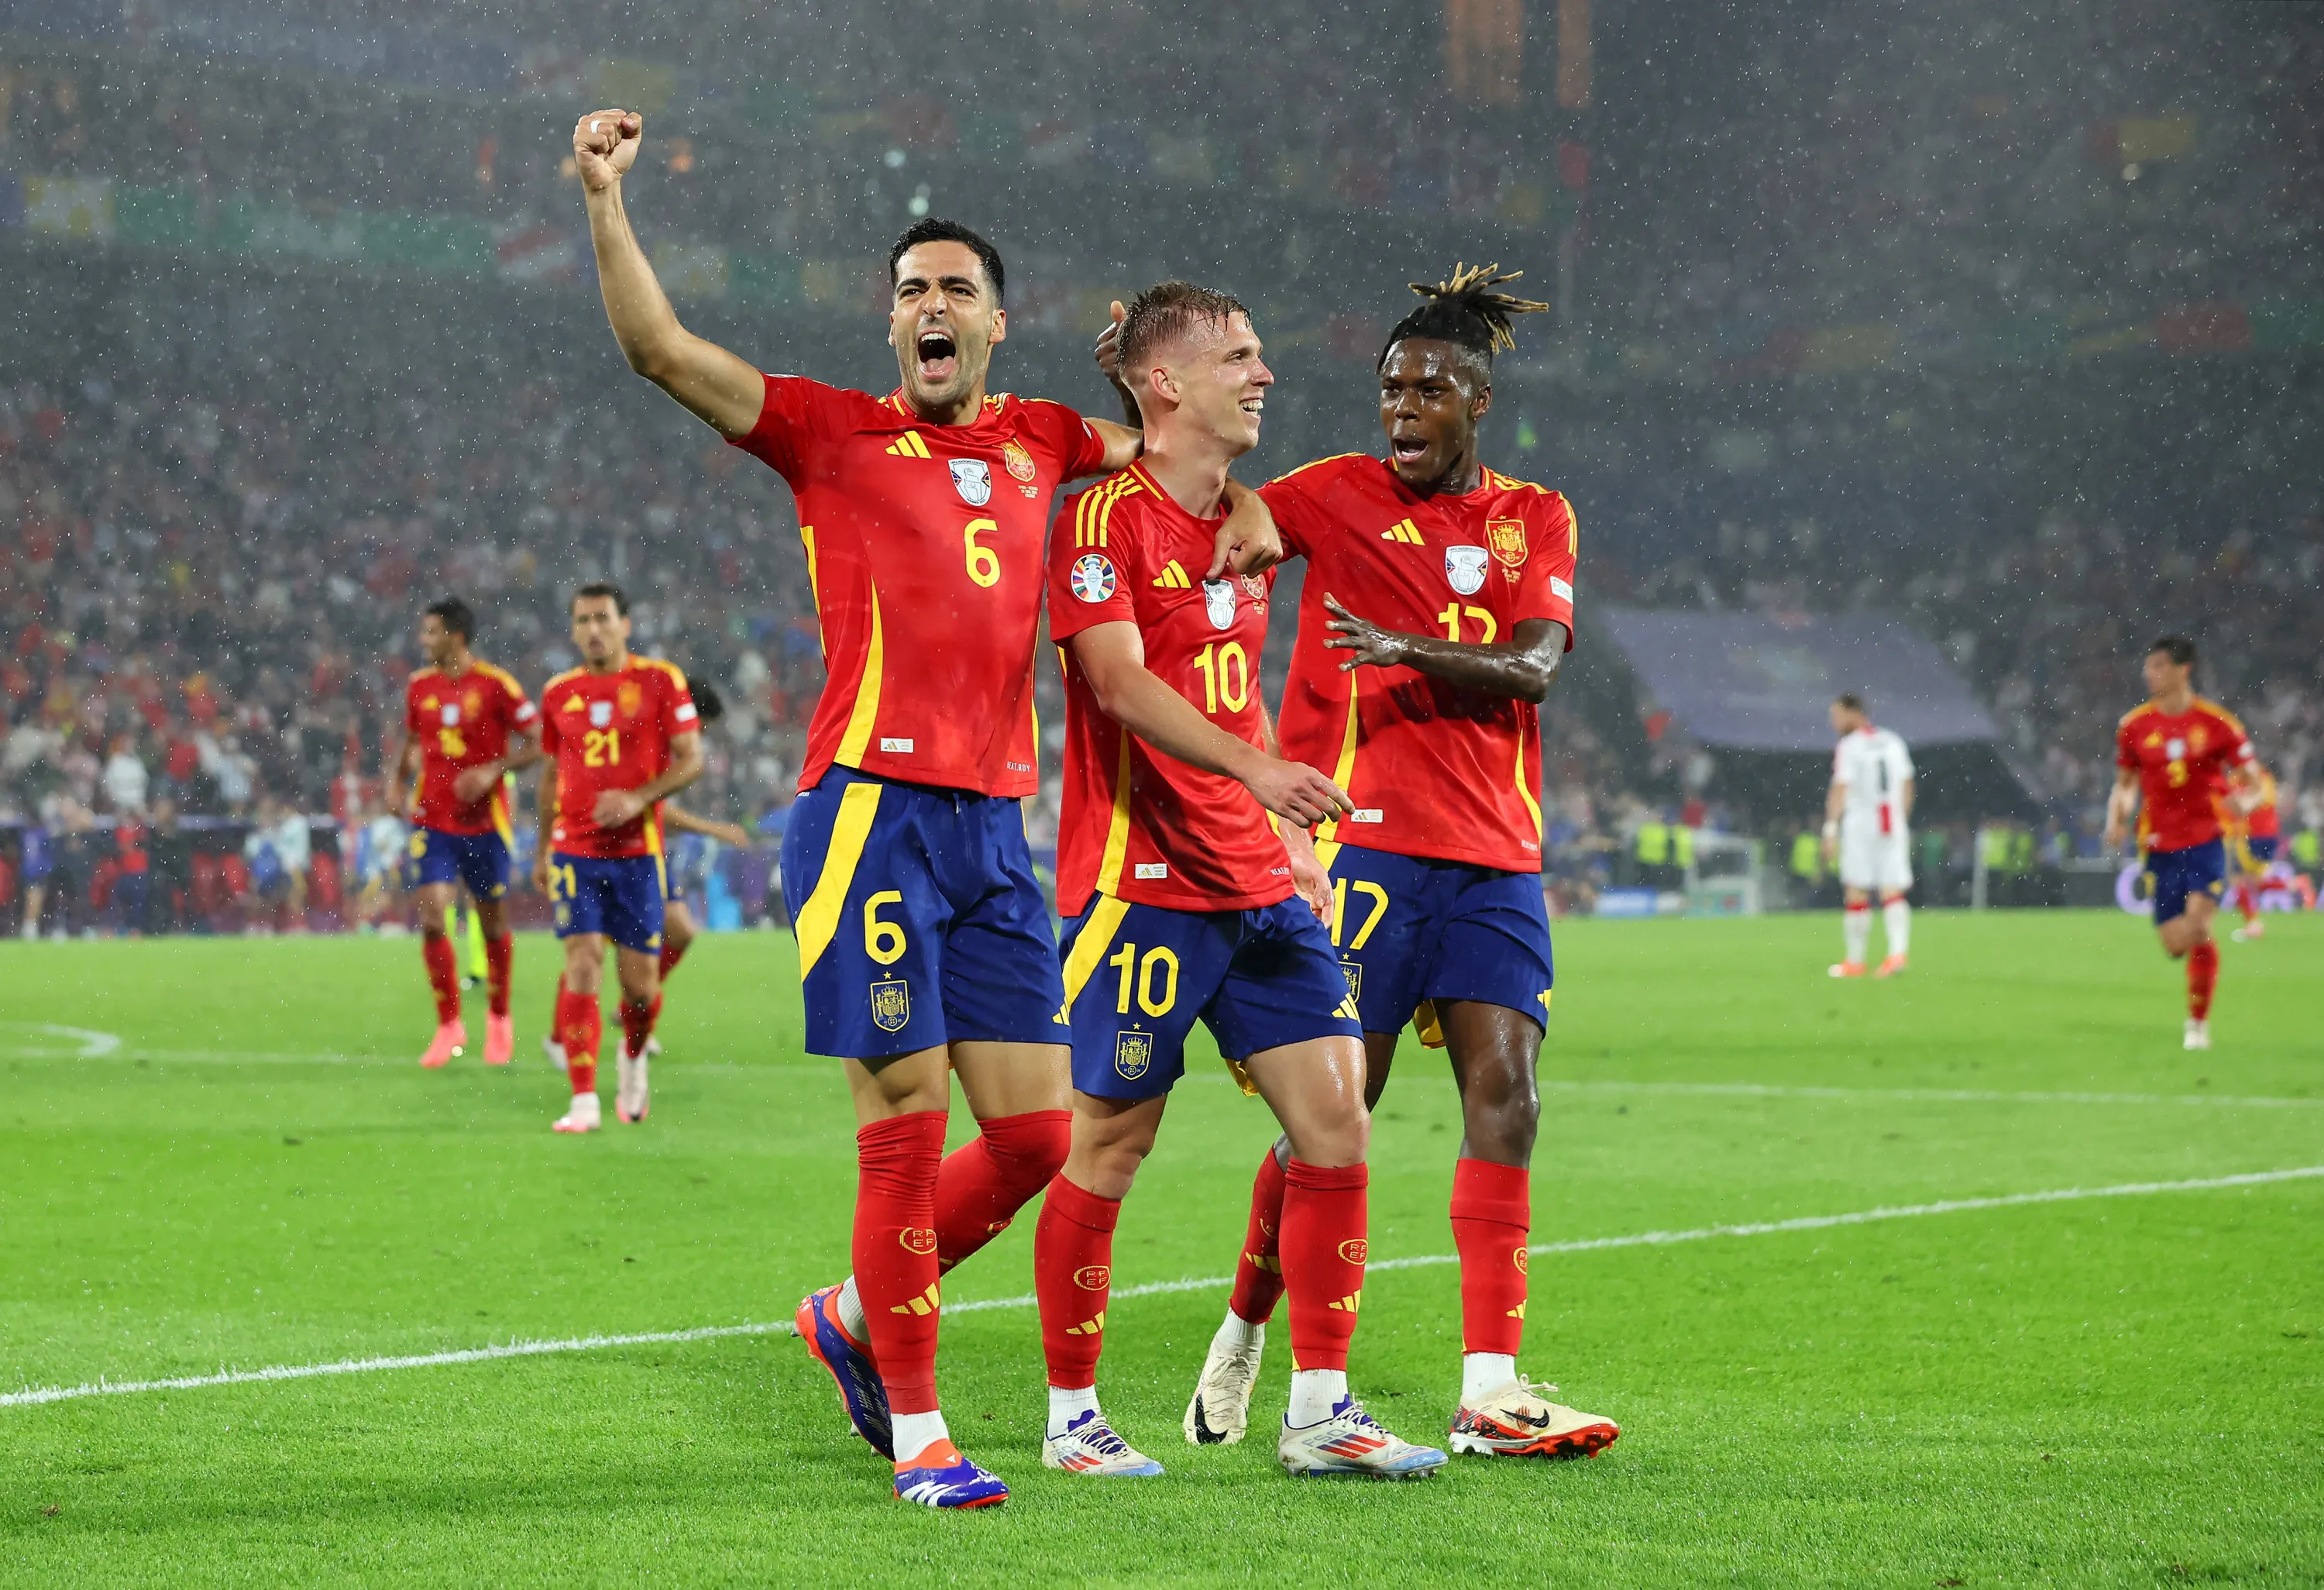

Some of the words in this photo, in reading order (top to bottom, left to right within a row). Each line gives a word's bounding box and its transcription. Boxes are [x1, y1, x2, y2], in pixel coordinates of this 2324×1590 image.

[964, 518, 1001, 588] 6
[1193, 642, 1250, 714] 10
[583, 727, 621, 768] 21
[547, 862, 577, 902] 21
[1330, 877, 1390, 951] 17
[864, 890, 907, 965] 6
[1109, 942, 1179, 1018] 10
